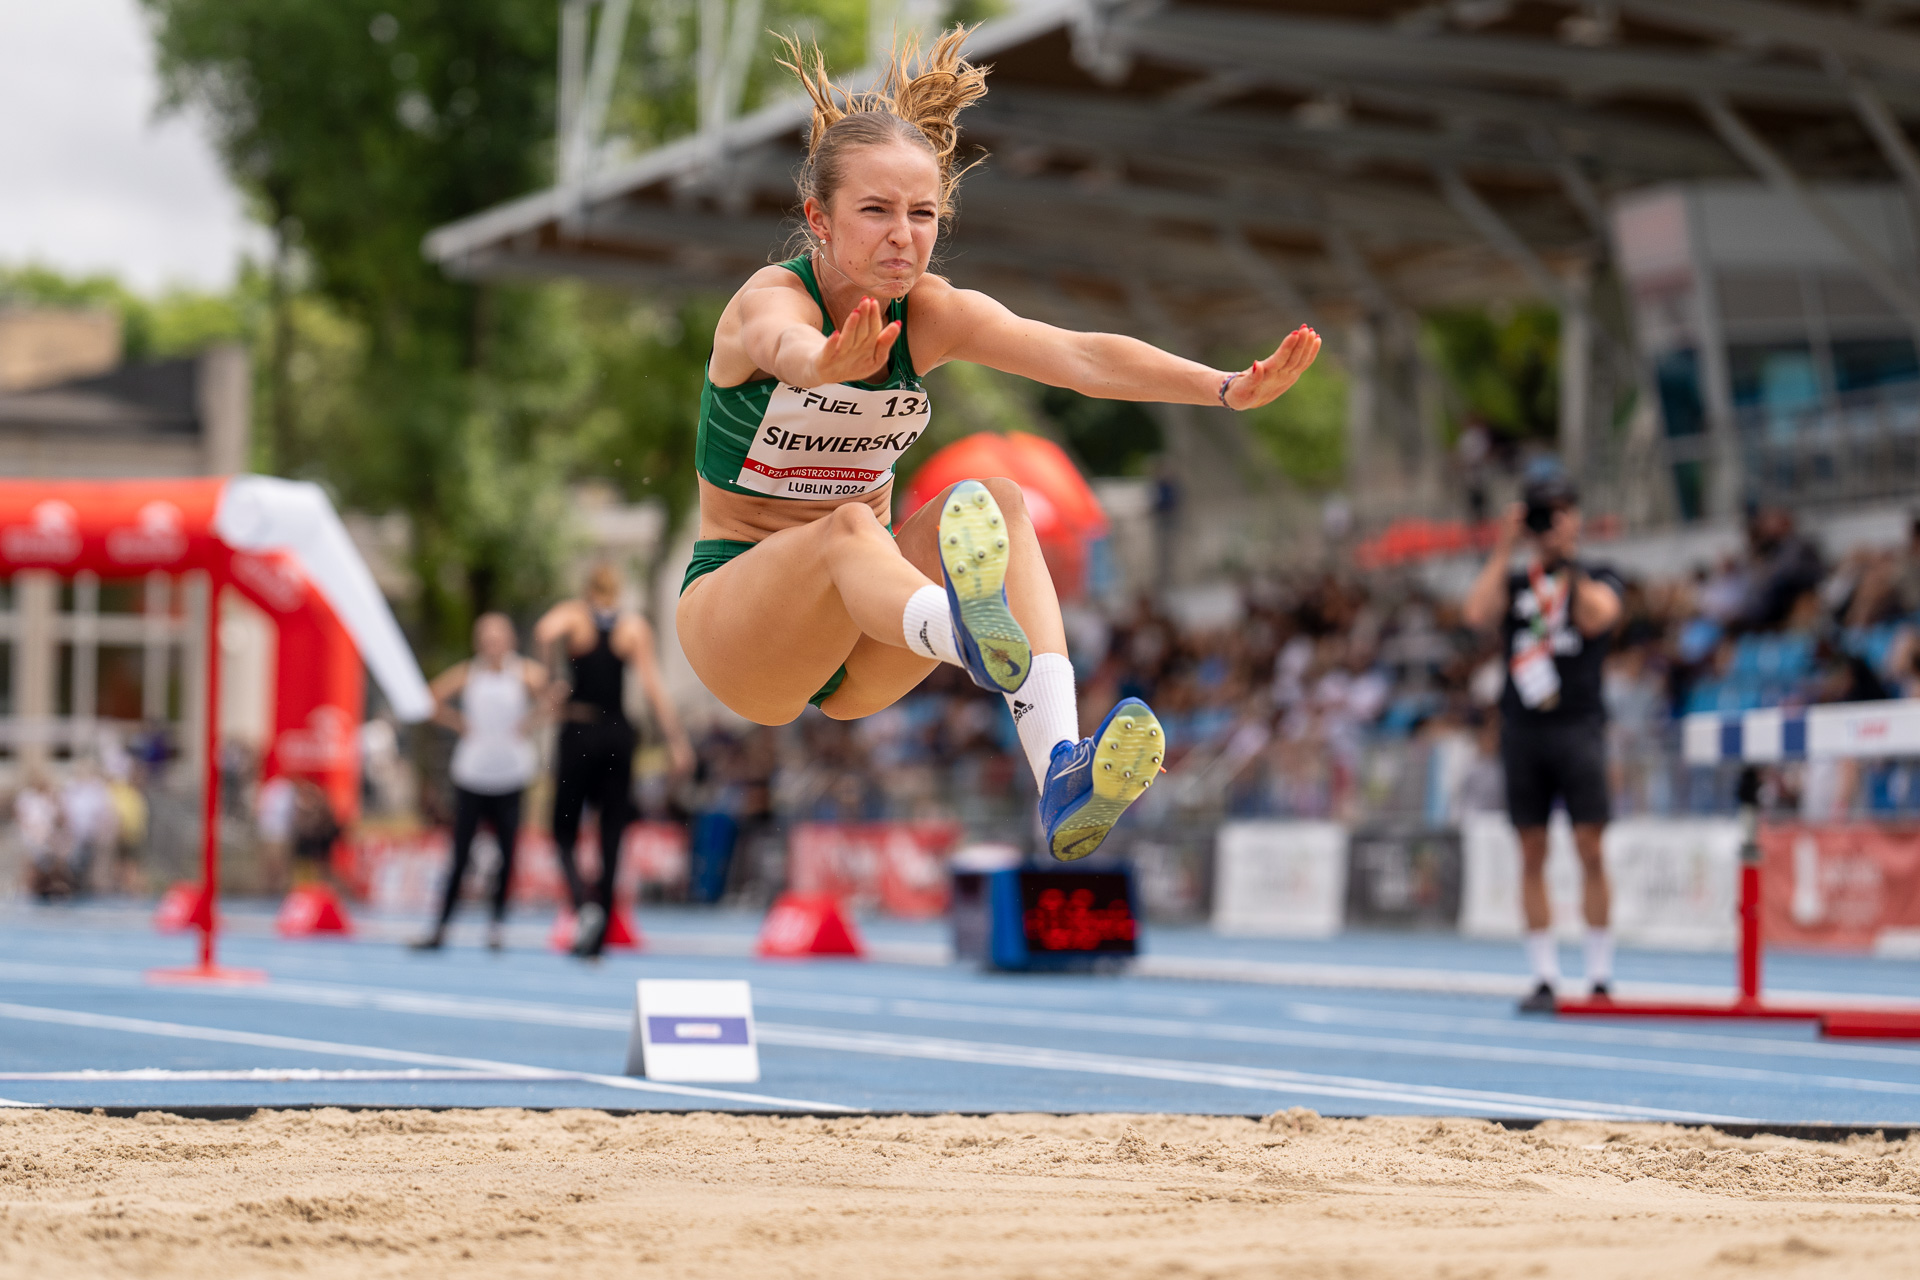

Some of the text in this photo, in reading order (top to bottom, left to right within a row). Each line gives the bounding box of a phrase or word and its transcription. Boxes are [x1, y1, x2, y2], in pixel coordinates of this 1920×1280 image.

[803, 391, 863, 415] FUEL
[762, 426, 918, 453] SIEWIERSKA
[754, 464, 766, 474] 41.
[767, 469, 789, 478] PZLA
[790, 468, 856, 479] MISTRZOSTWA
[788, 481, 866, 495] LUBLIN 2024
